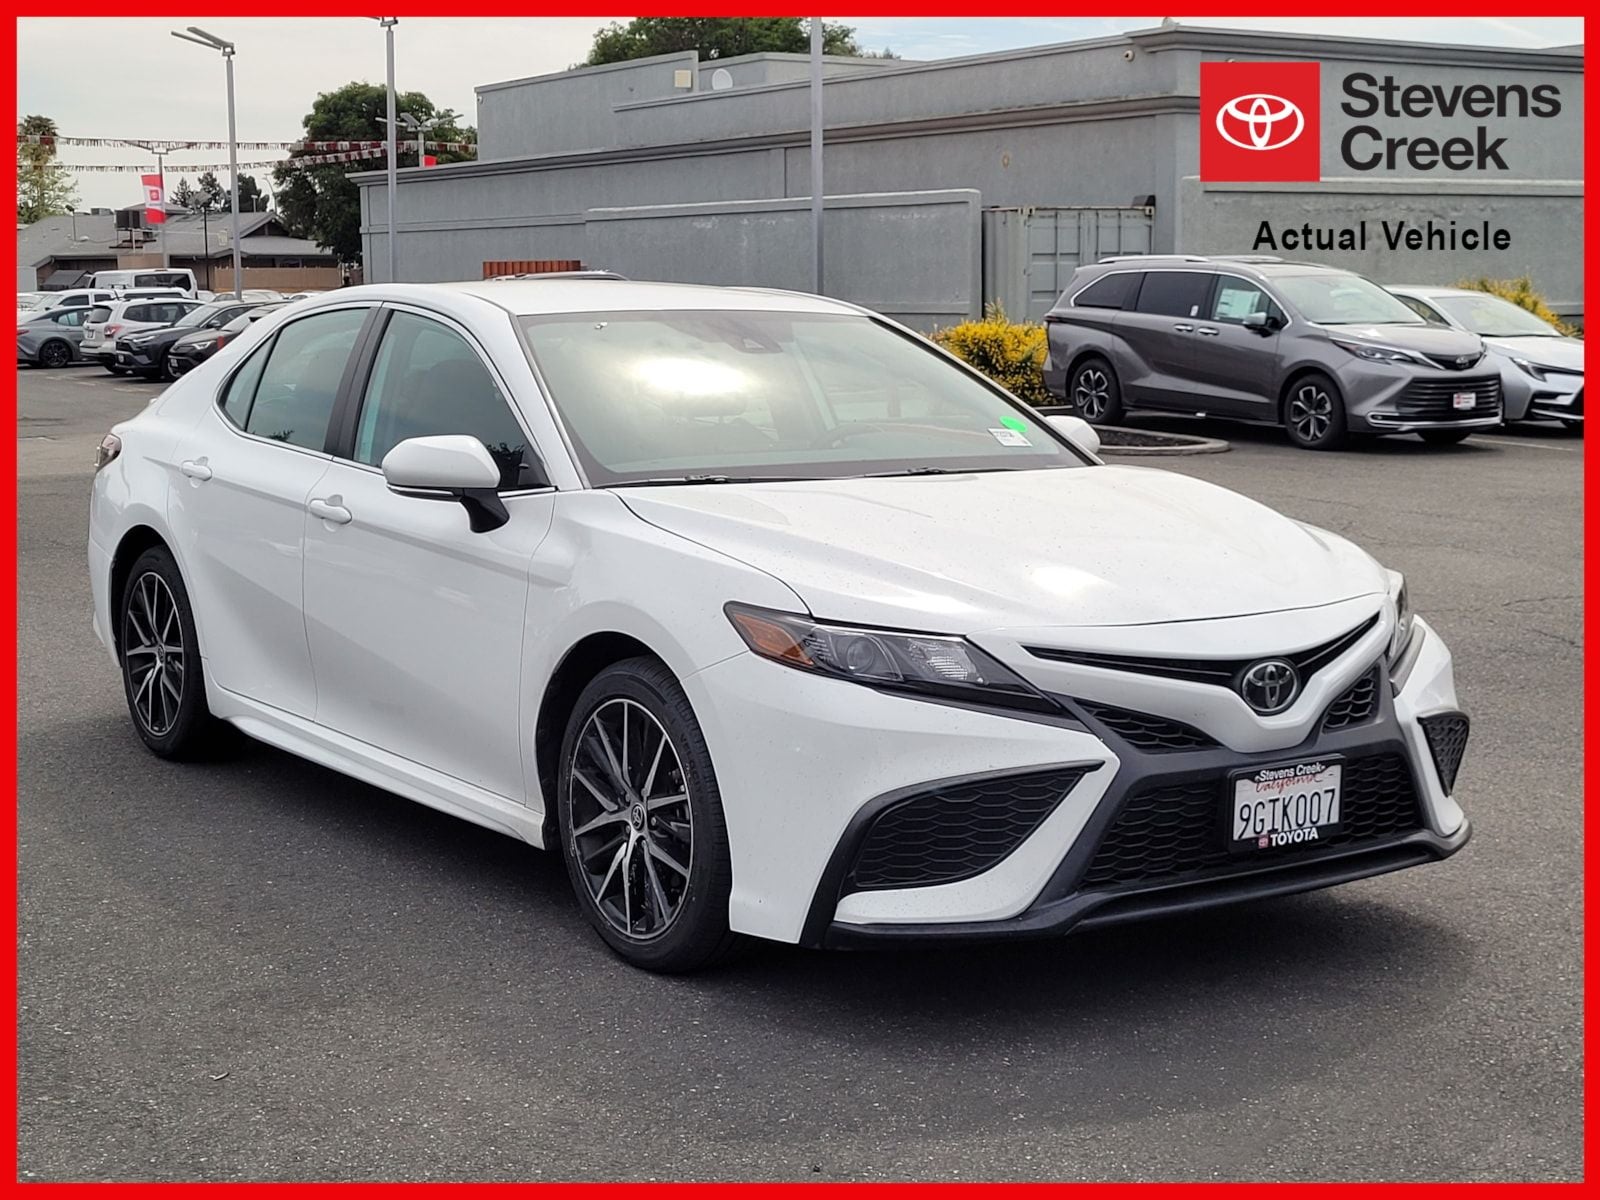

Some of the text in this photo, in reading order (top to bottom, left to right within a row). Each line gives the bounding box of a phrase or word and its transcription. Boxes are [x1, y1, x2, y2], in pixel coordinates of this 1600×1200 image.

[1260, 762, 1322, 782] Stevens Creek
[1238, 788, 1336, 840] 9GIK007
[1270, 827, 1319, 847] TOYOTA
